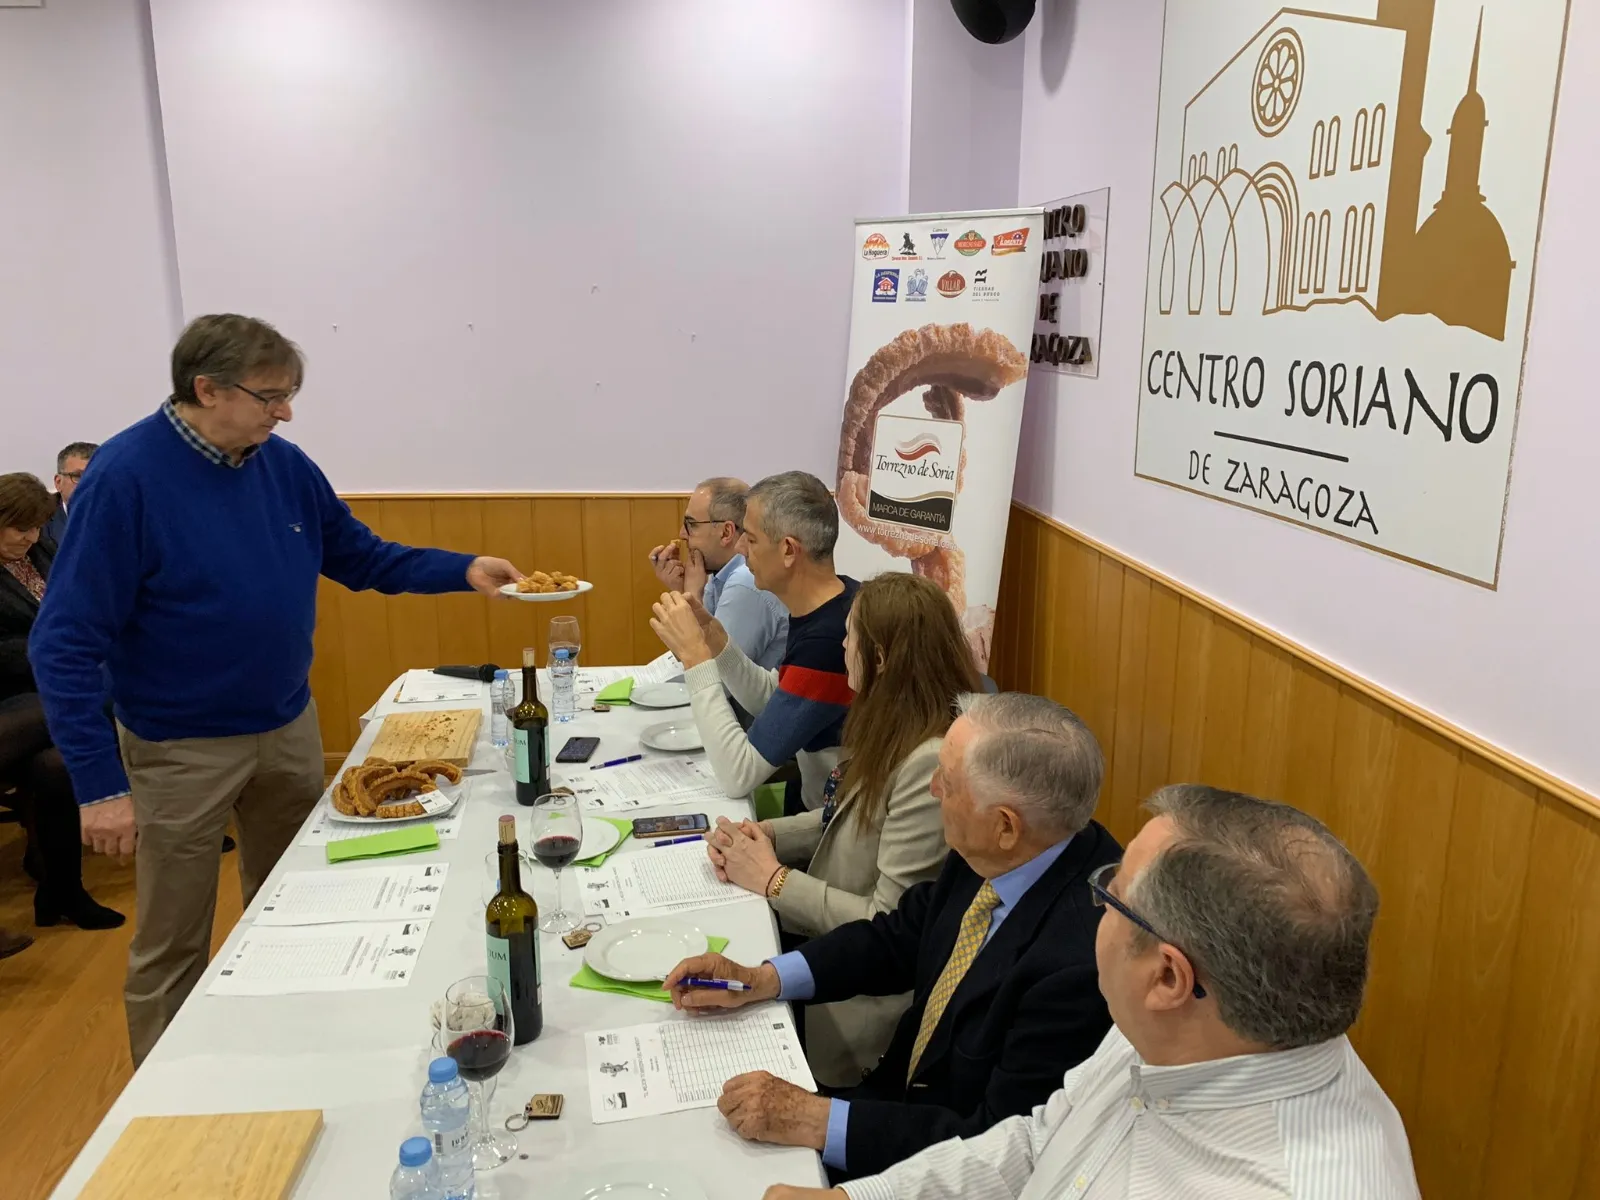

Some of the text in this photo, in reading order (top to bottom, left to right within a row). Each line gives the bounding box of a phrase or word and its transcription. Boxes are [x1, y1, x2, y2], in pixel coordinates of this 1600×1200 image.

[1040, 292, 1059, 323] DE
[1147, 349, 1500, 444] CENTRO SORIANO
[875, 454, 955, 481] Torrezno de Soria
[1188, 450, 1379, 535] DE ZARAGOZA
[872, 502, 947, 525] MARCA DE GARANTÍA
